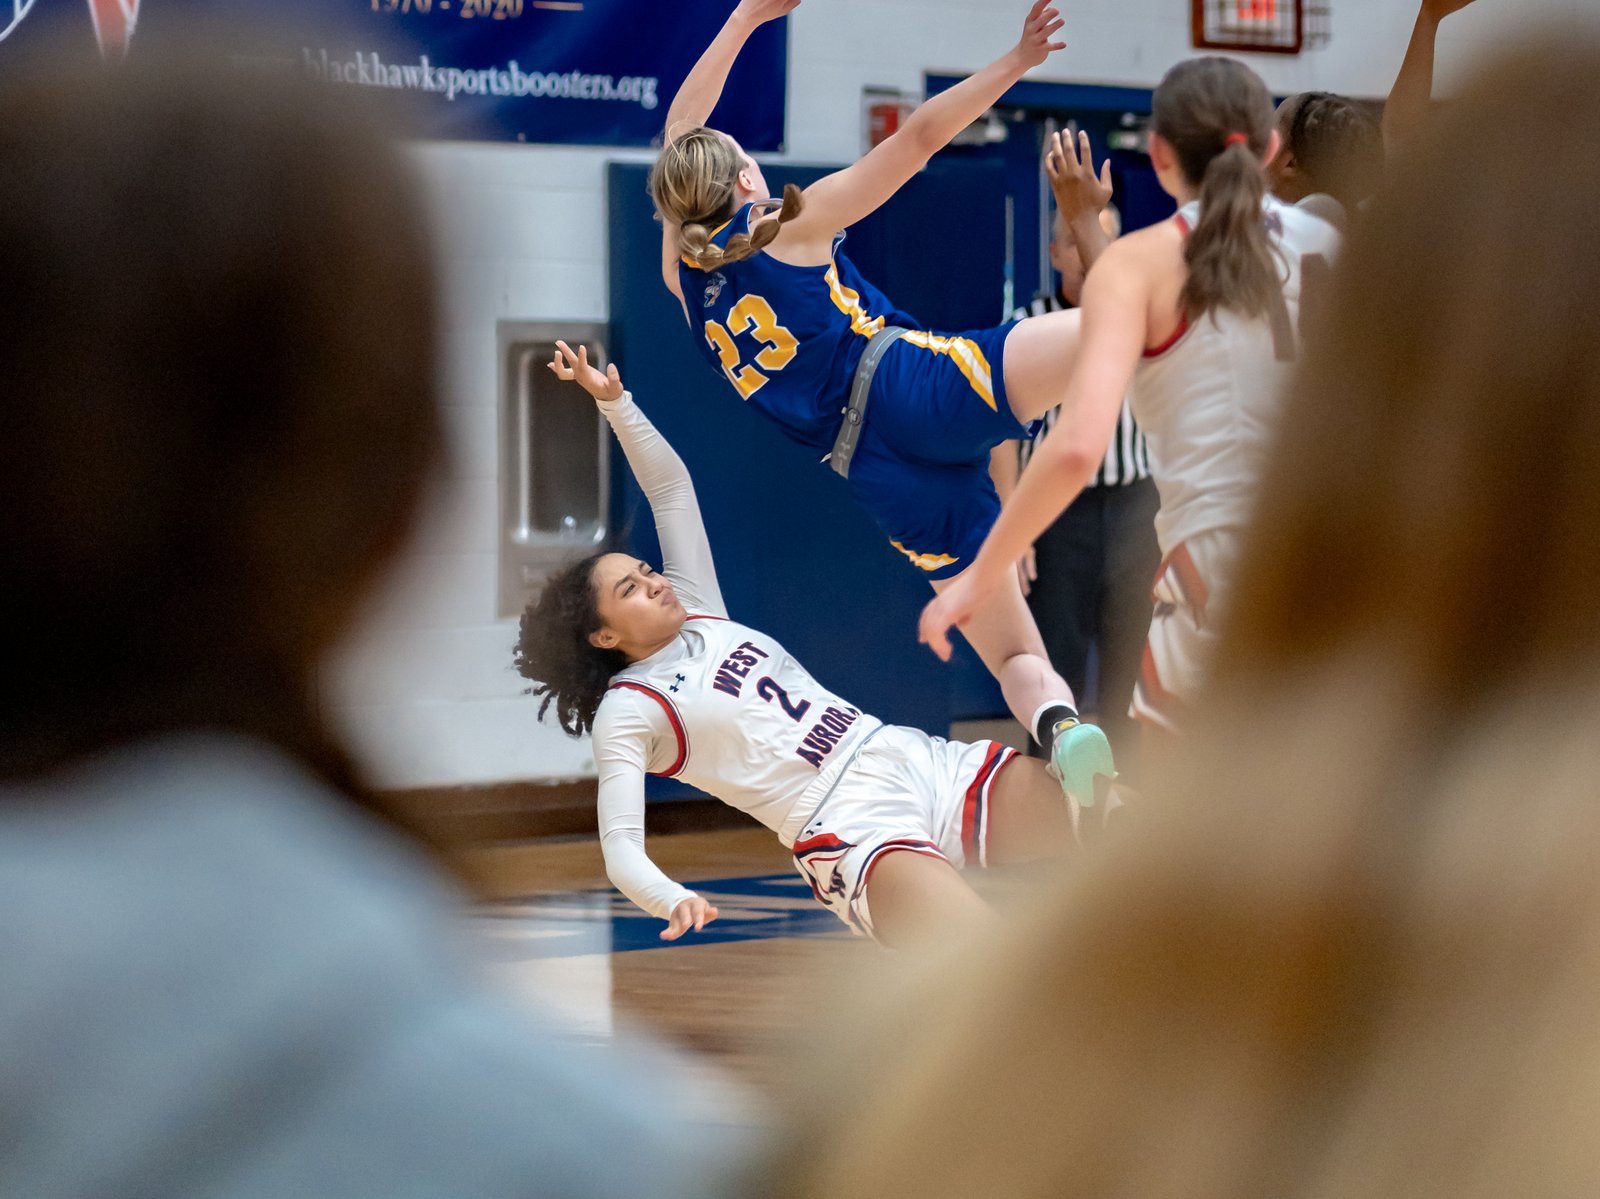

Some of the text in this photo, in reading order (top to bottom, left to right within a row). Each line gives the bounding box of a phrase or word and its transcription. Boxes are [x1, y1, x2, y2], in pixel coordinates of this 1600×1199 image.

[705, 293, 801, 401] 23
[713, 641, 770, 698] WEST
[756, 675, 812, 723] 2
